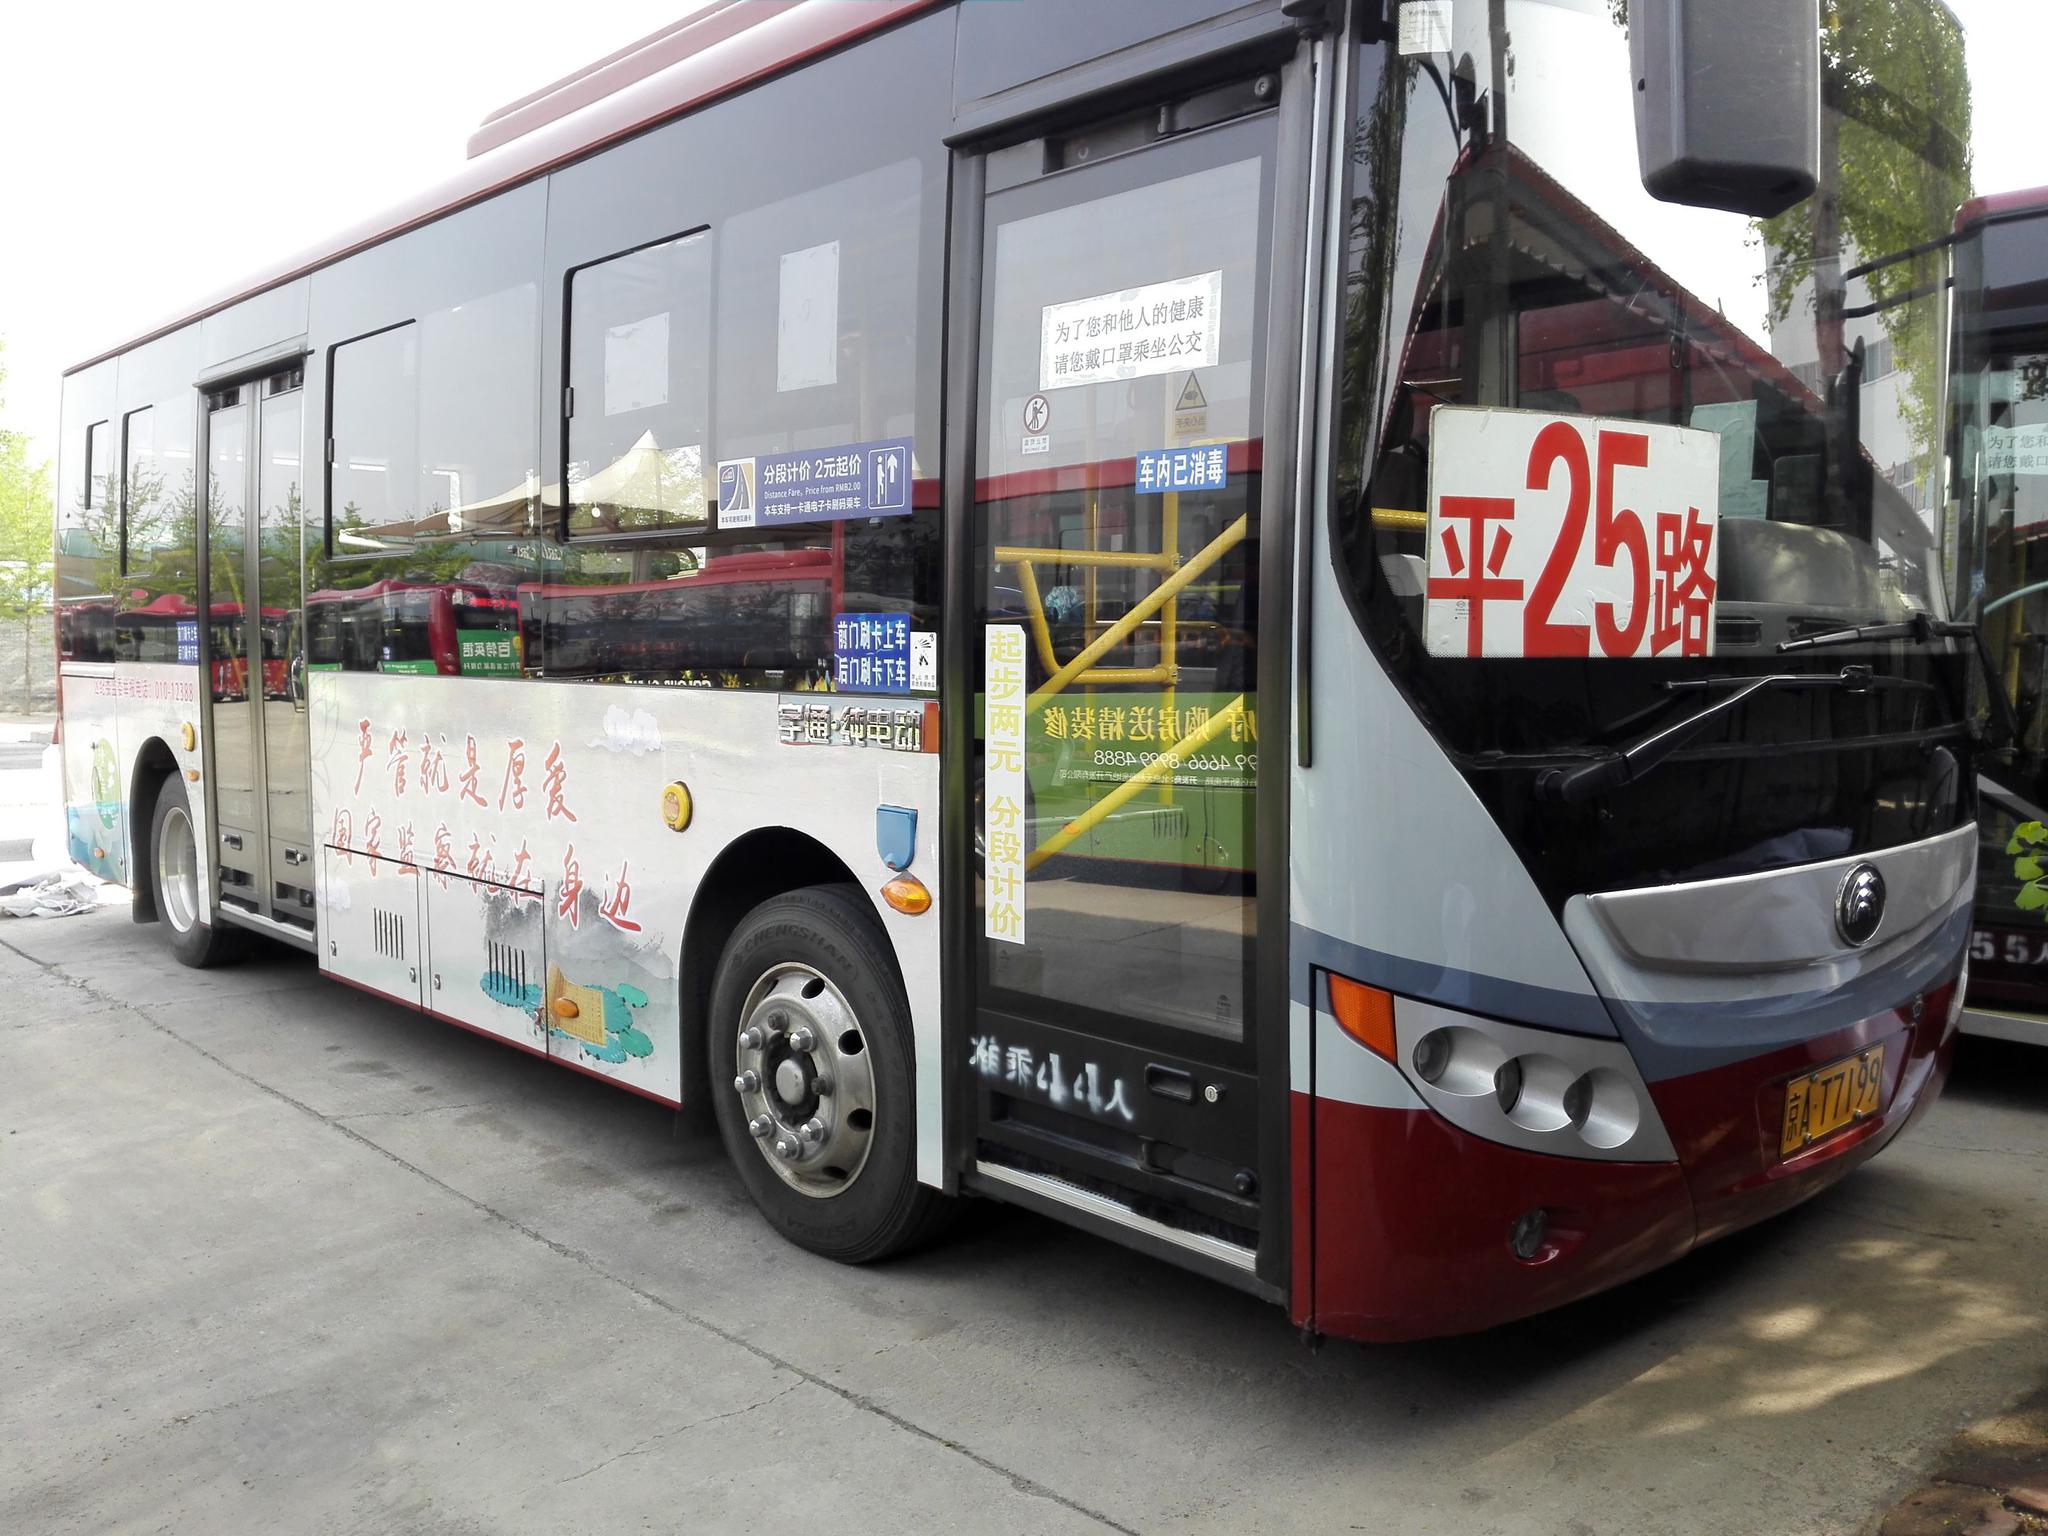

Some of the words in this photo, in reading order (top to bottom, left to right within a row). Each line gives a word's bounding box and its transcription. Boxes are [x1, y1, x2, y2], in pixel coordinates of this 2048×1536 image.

[1055, 295, 1204, 344] 为了您和他人的健康
[1054, 330, 1202, 376] 请您戴口罩乘坐公交
[764, 461, 811, 486] 分段计价
[815, 453, 862, 479] 2元起价
[764, 490, 787, 500] Distance
[805, 486, 820, 496] Price
[820, 484, 835, 494] from
[835, 481, 861, 492] RMB2.00
[1139, 448, 1224, 489] 车内已消毒
[764, 496, 861, 516] 本车支持一卡通电子卡刷码乘车
[1427, 421, 1717, 658] 平25路
[837, 620, 906, 651] 前门刷卡上车
[838, 656, 906, 687] 后门刷卡下车
[989, 630, 1022, 774] 起步两元
[353, 717, 578, 822] 严管就是厚爱
[331, 807, 643, 933] 国家监察就在身边
[988, 795, 1022, 938] 分段计价
